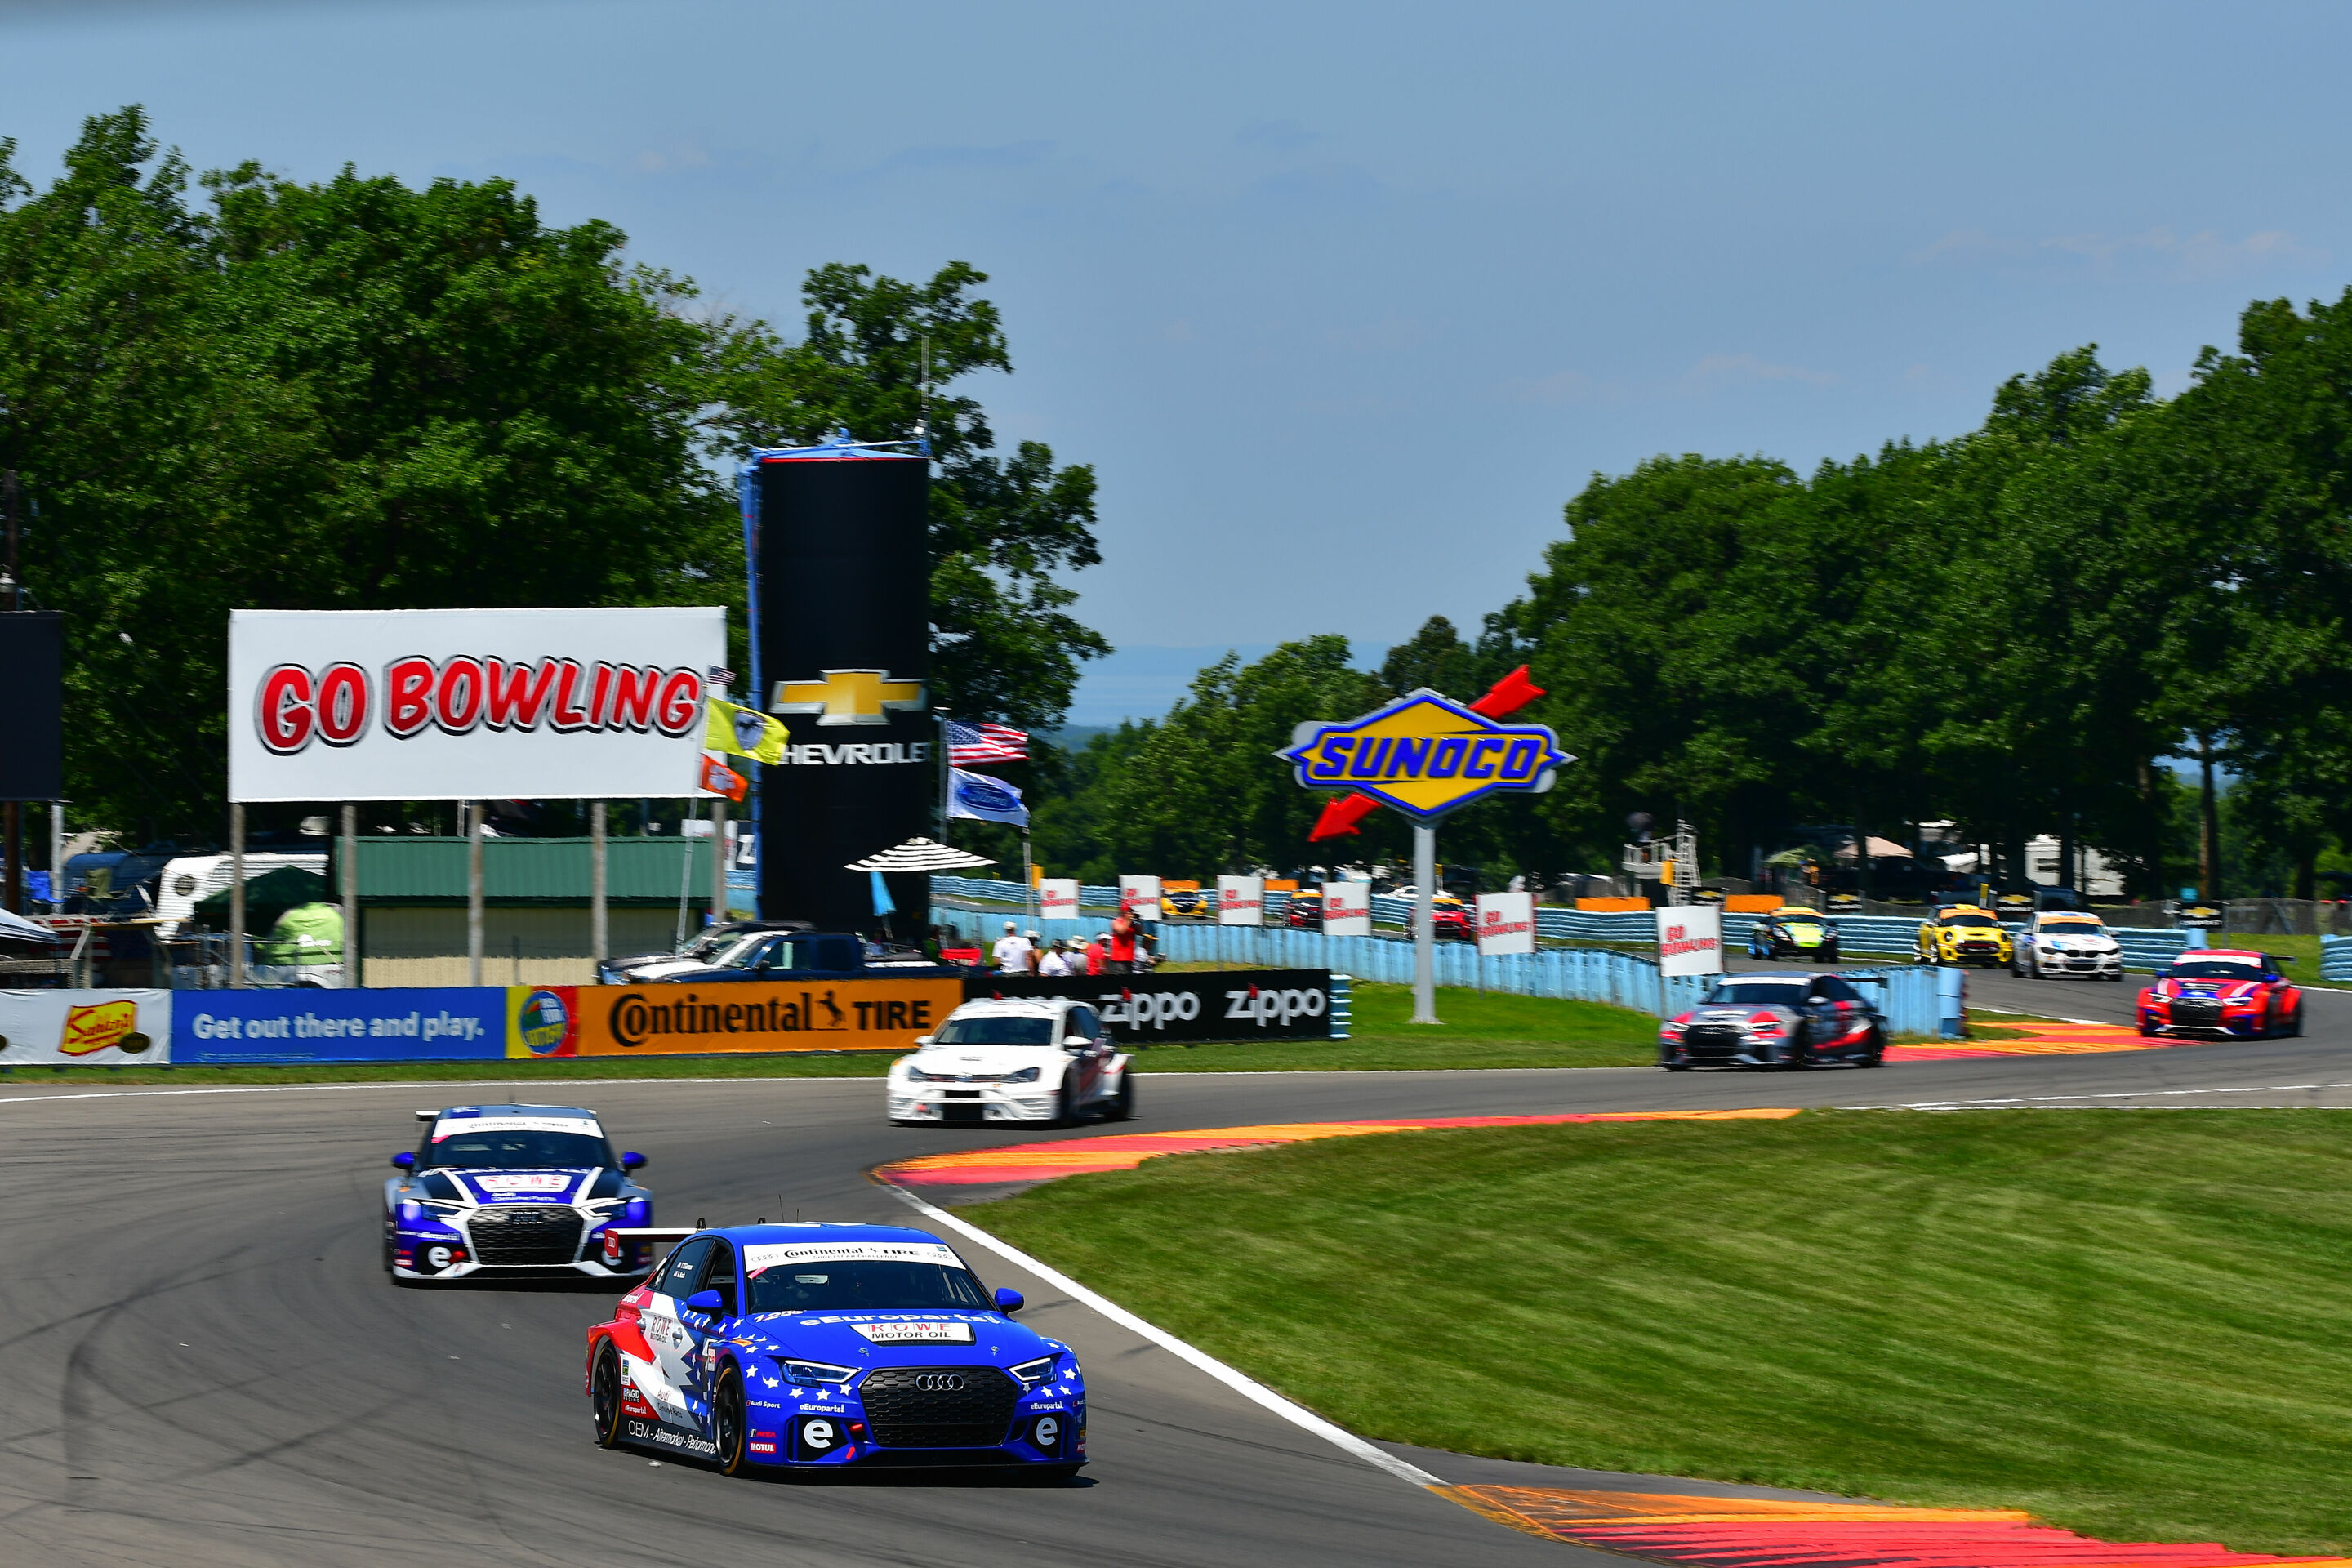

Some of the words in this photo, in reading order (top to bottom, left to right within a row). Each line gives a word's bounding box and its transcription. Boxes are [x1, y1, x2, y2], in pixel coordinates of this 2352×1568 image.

[255, 660, 374, 756] GO
[383, 654, 706, 739] BOWLING
[776, 742, 933, 765] HEVROLE
[1312, 736, 1542, 779] SUNOCO
[193, 1013, 242, 1039] Get
[245, 1017, 290, 1038] out
[293, 1012, 366, 1038] there
[368, 1011, 420, 1037] and
[422, 1010, 485, 1042] play.
[608, 992, 812, 1047] Continental
[851, 1000, 931, 1031] TIRE
[784, 1247, 863, 1258] Continental
[878, 1248, 920, 1256] TIRE
[651, 1316, 673, 1336] ROWE
[871, 1322, 951, 1332] ROWE
[871, 1331, 924, 1339] MOTOR
[928, 1331, 951, 1339] OIL
[657, 1387, 671, 1402] Audi
[763, 1401, 781, 1409] Sport
[629, 1420, 650, 1439] OEM
[653, 1428, 685, 1446] Aftermarket
[804, 1419, 833, 1449] e
[1036, 1417, 1058, 1446] e
[750, 1442, 775, 1452] MOTUL
